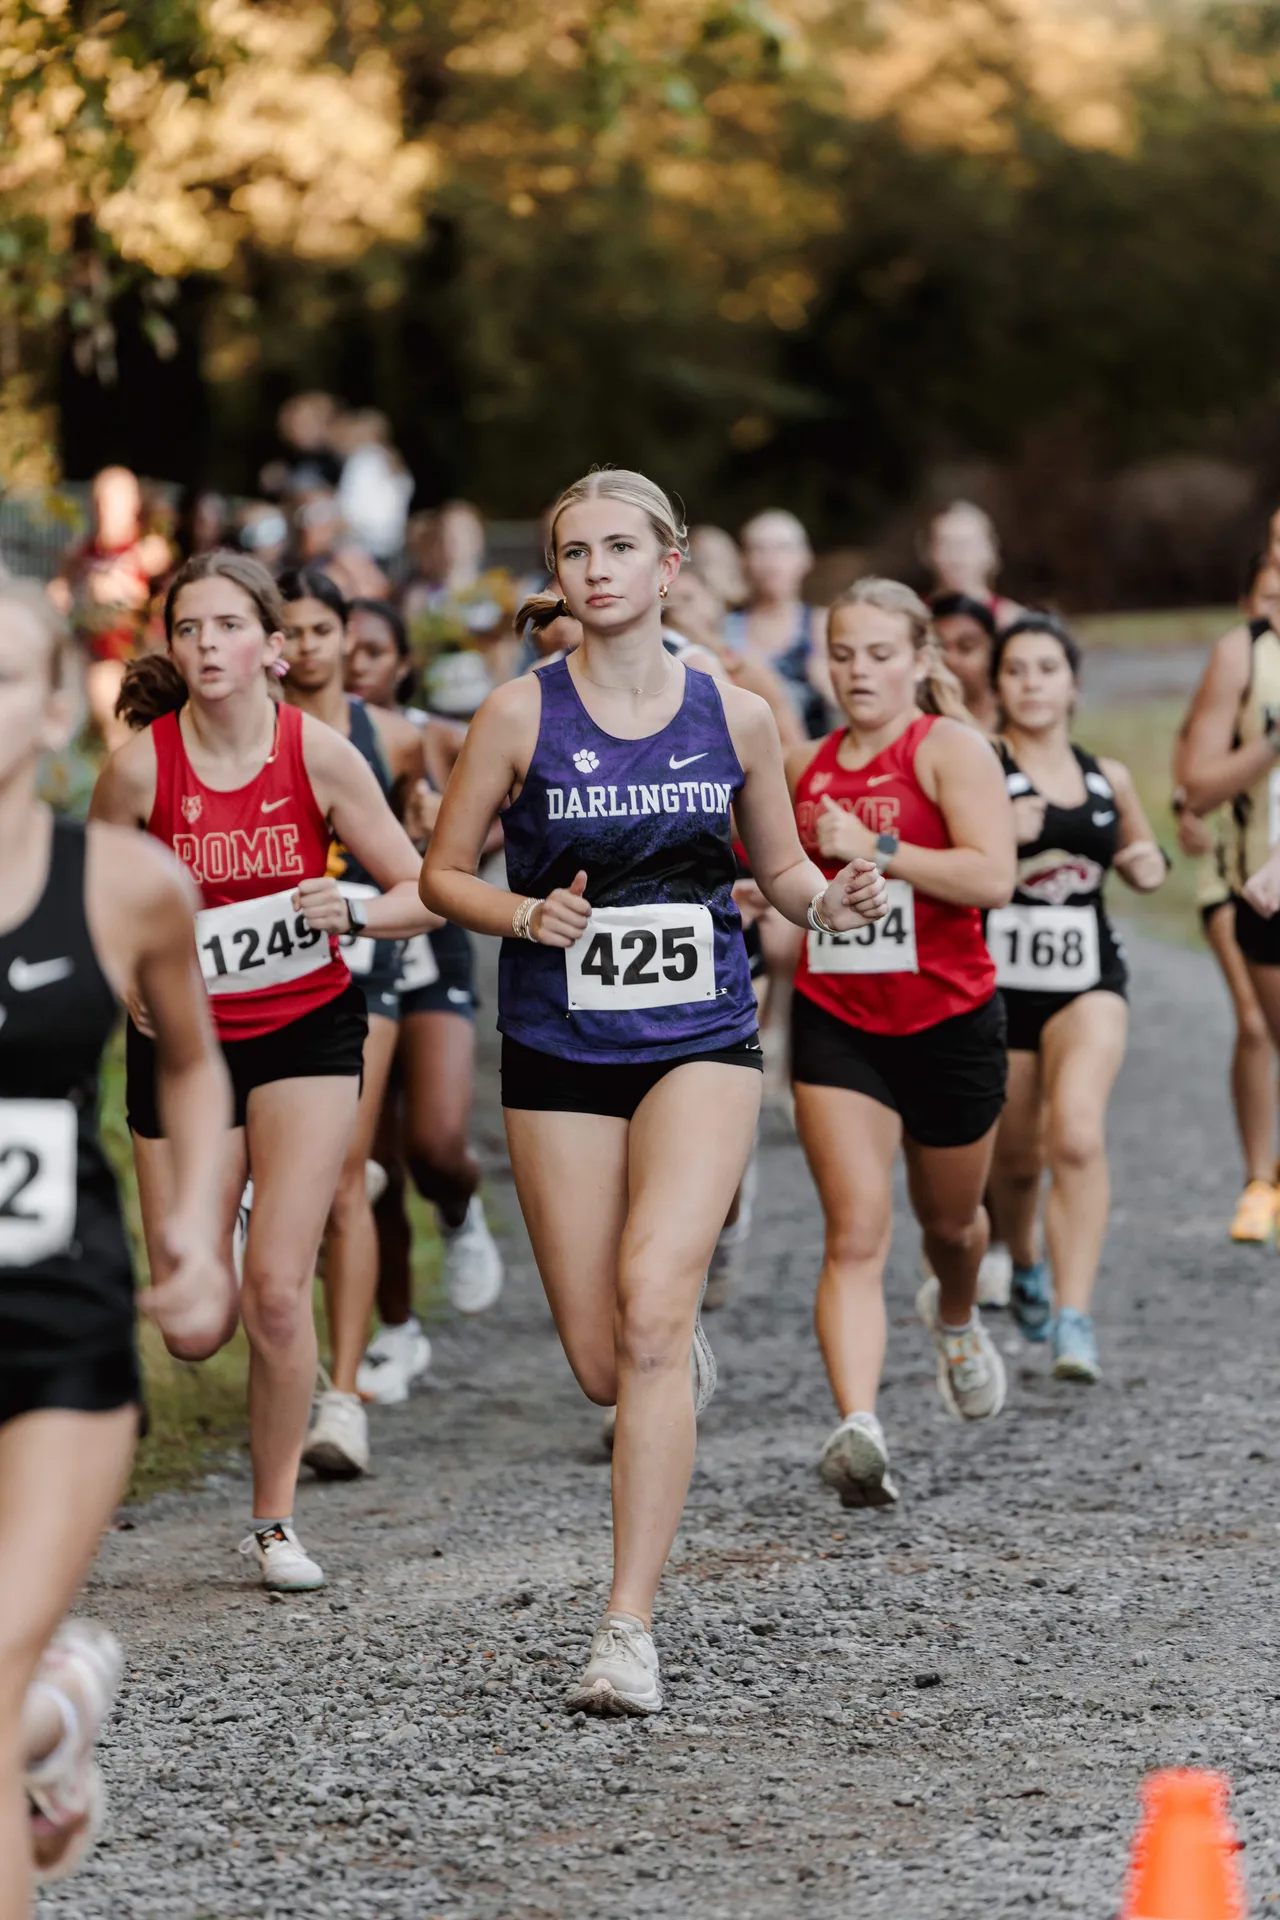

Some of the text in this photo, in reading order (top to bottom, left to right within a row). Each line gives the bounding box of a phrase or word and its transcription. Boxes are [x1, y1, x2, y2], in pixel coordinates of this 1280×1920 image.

[547, 782, 731, 819] DARLINGTON
[173, 824, 304, 884] ROME
[202, 914, 322, 976] 1249
[581, 926, 698, 986] 425
[1005, 929, 1083, 967] 168
